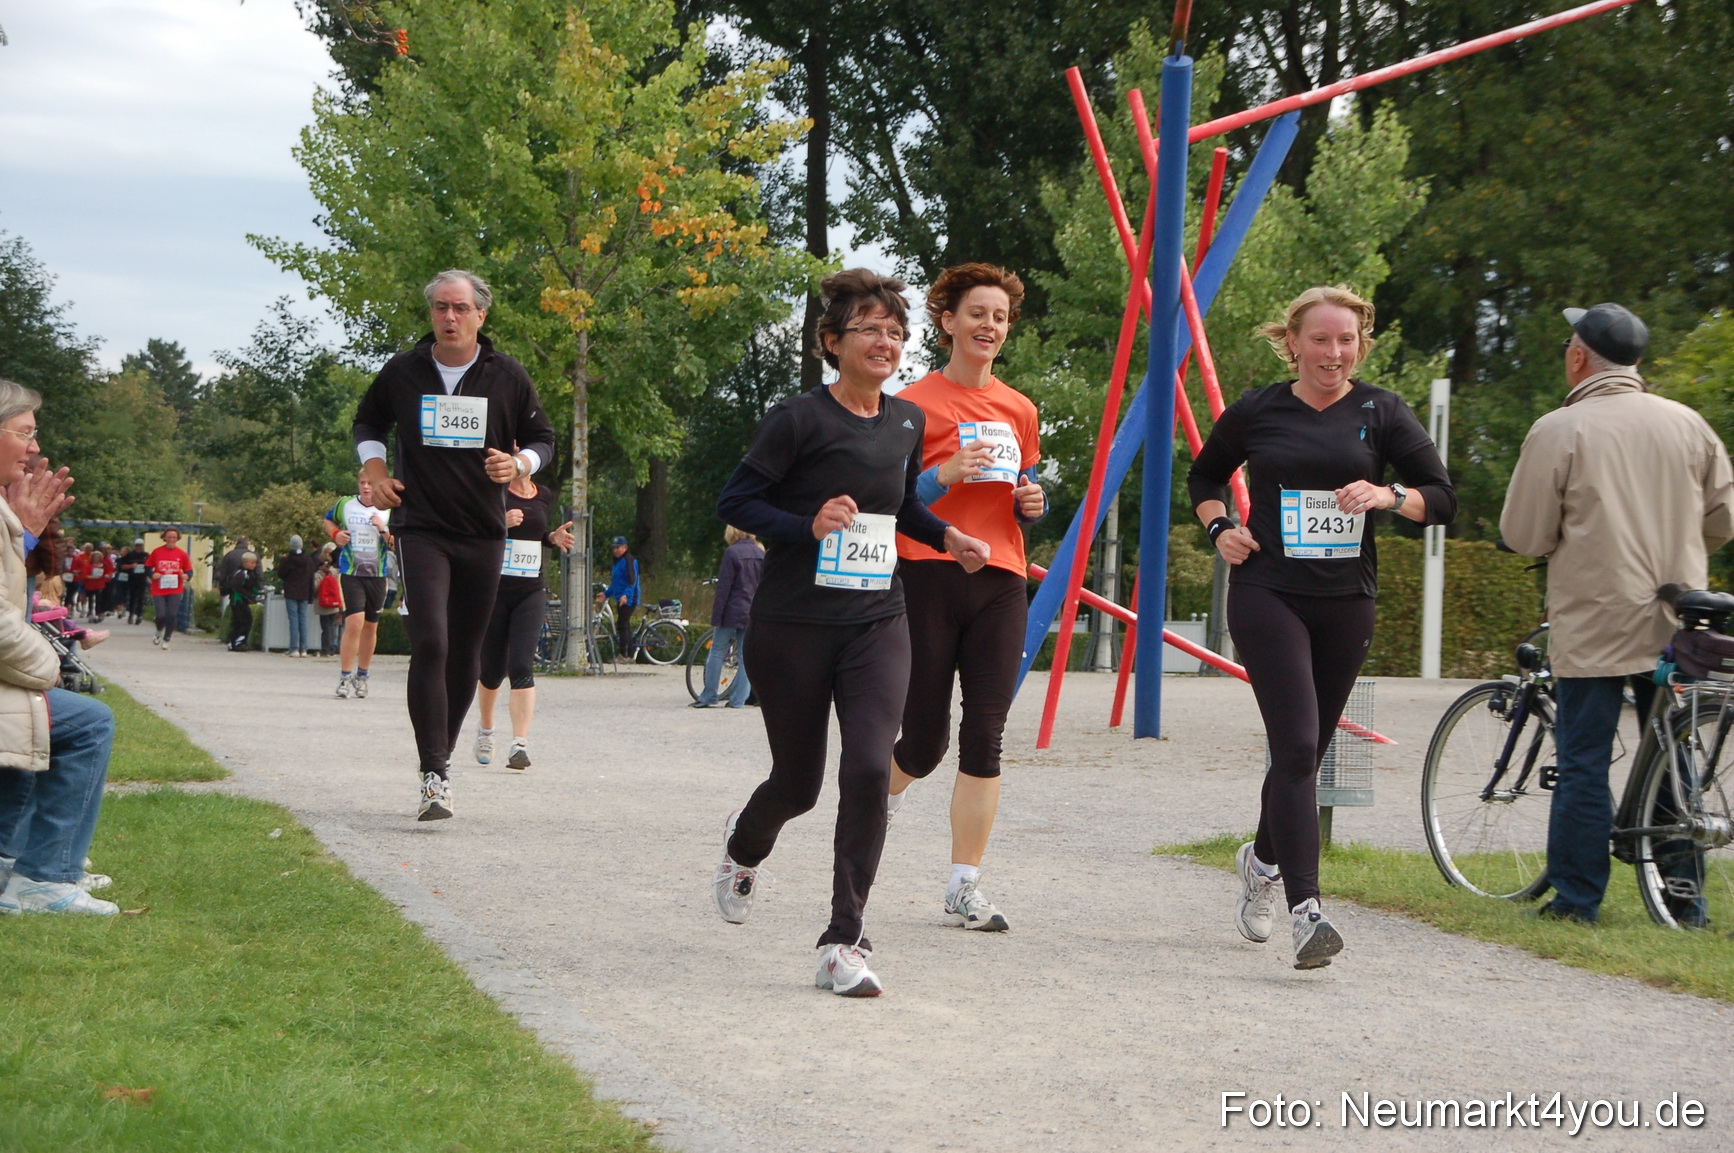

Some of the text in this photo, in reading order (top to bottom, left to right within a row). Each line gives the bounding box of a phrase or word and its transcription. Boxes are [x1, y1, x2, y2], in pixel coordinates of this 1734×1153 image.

[439, 402, 474, 414] Matthias
[441, 415, 479, 430] 3486
[1305, 496, 1337, 509] Gisela
[848, 520, 867, 534] Rita
[1307, 516, 1355, 534] 2431
[513, 553, 538, 564] 3707
[846, 542, 888, 563] 2447
